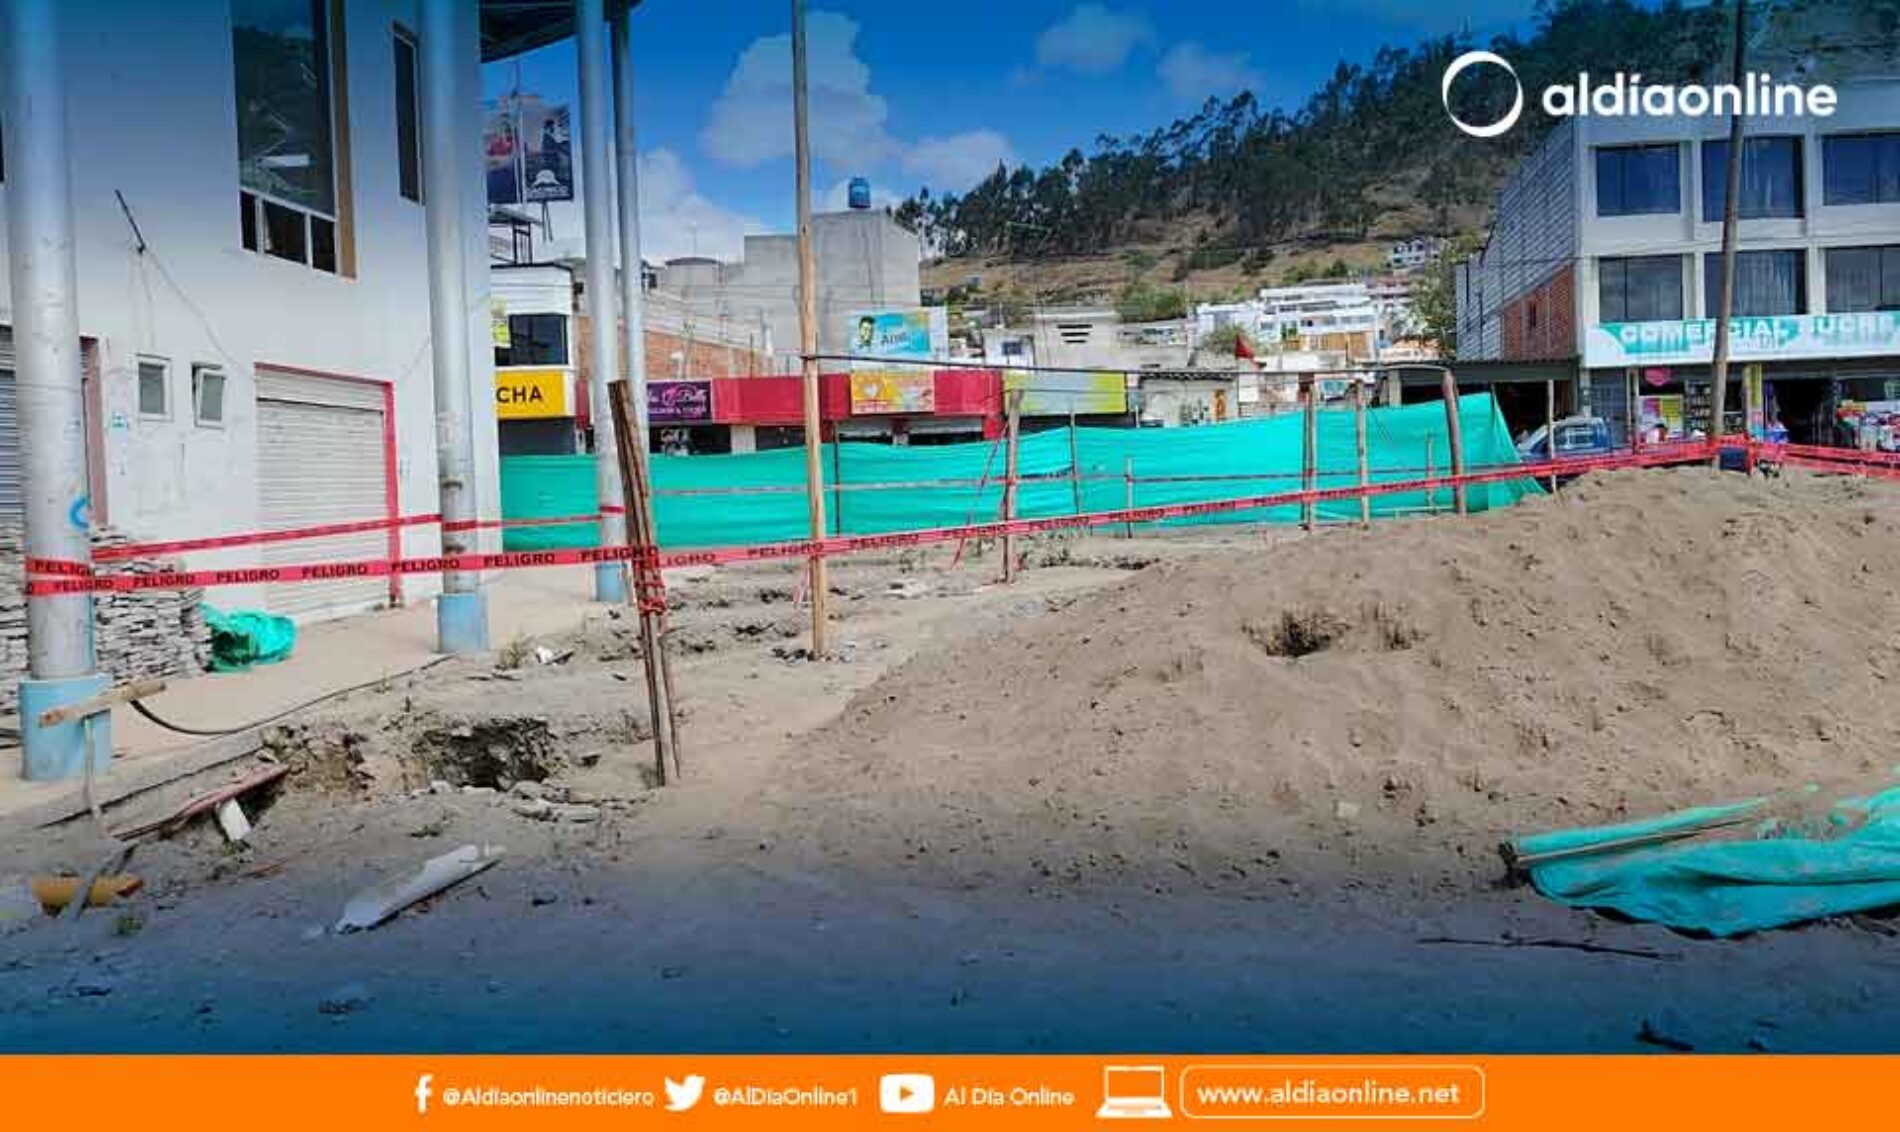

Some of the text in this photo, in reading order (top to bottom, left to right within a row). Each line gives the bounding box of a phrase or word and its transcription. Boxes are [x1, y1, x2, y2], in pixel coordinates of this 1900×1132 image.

[133, 575, 195, 589] PELIGRO
[216, 568, 280, 584] PELIGRO
[302, 563, 367, 579] PELIGRO
[391, 558, 460, 572] PELIGRO
[483, 553, 555, 568] PELIGRO
[747, 543, 824, 558] PELIGRO
[849, 533, 919, 549] PELIGRO
